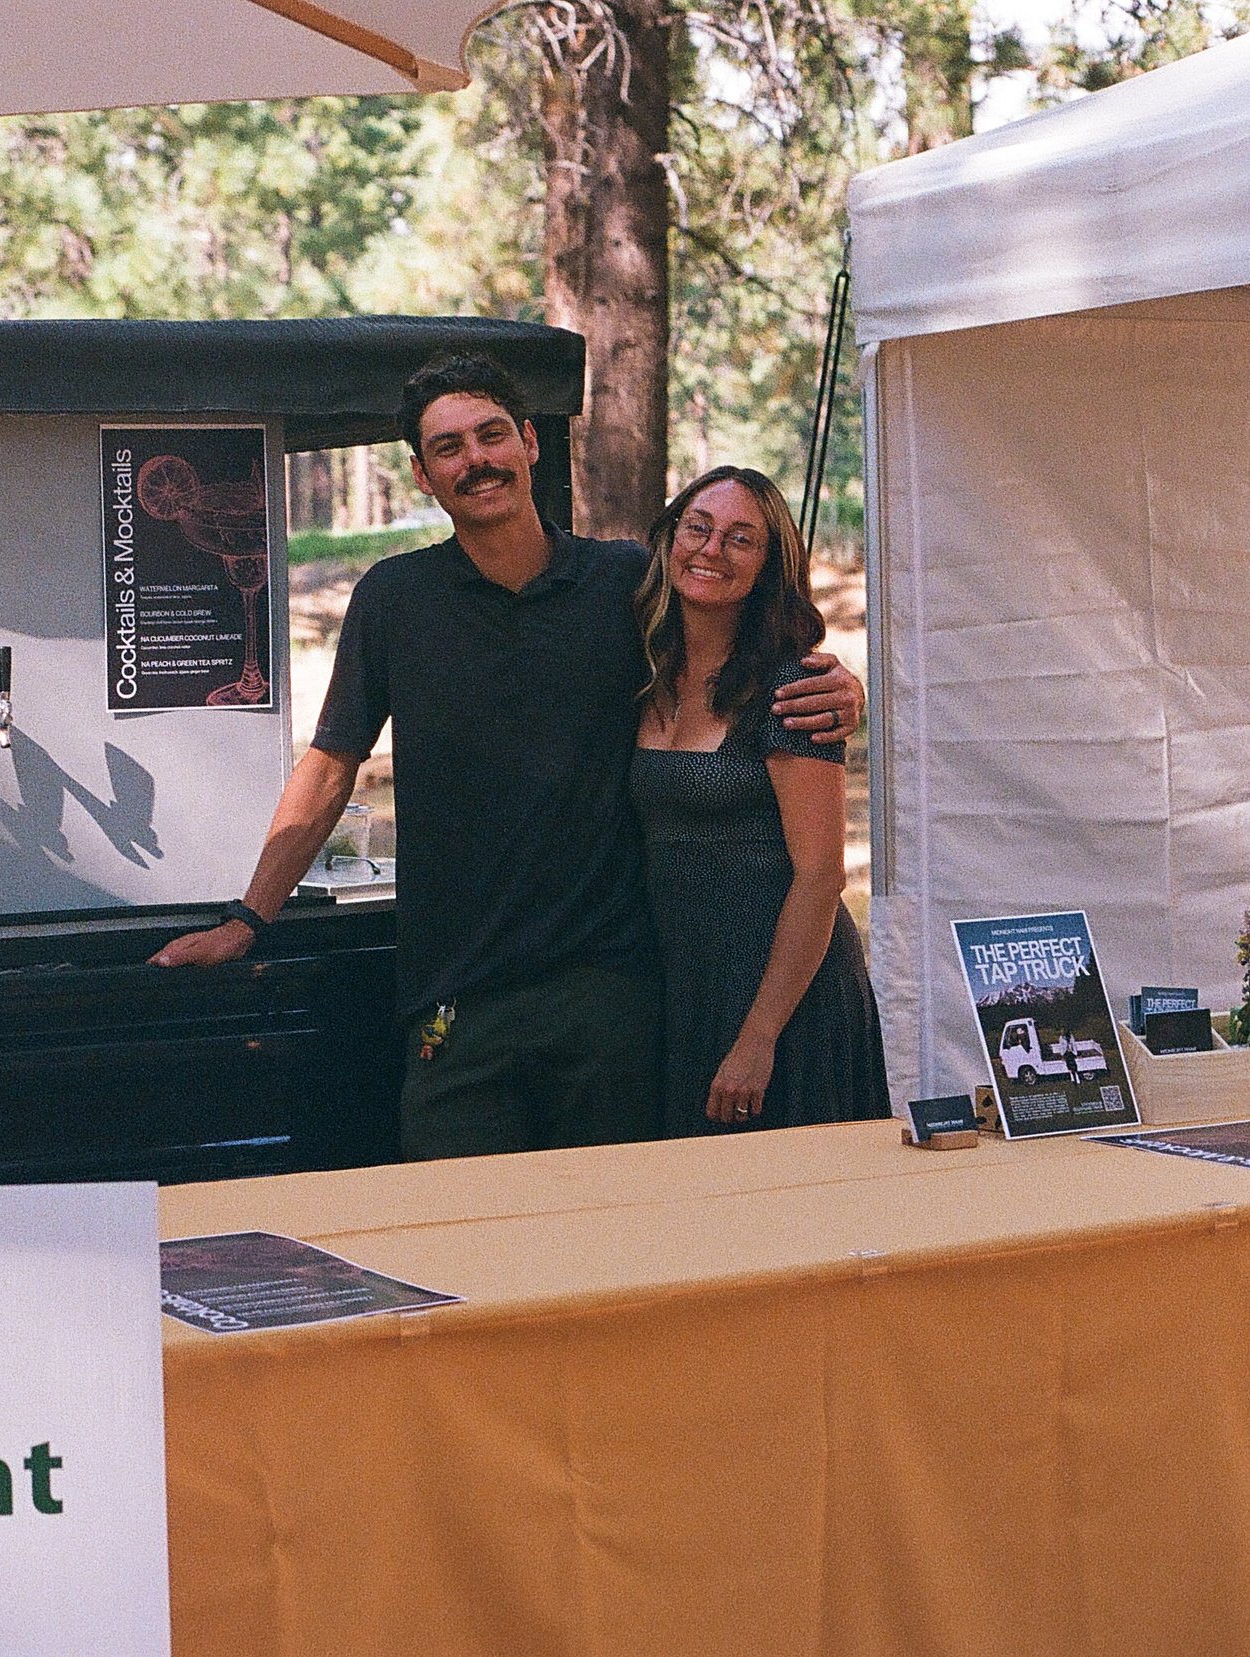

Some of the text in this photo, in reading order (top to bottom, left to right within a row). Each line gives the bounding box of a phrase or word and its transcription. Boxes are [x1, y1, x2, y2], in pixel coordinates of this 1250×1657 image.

[111, 449, 138, 699] Cocktails & Mocktails
[970, 937, 1081, 964] THE PERFECT
[975, 955, 1090, 985] TAP TRUCK
